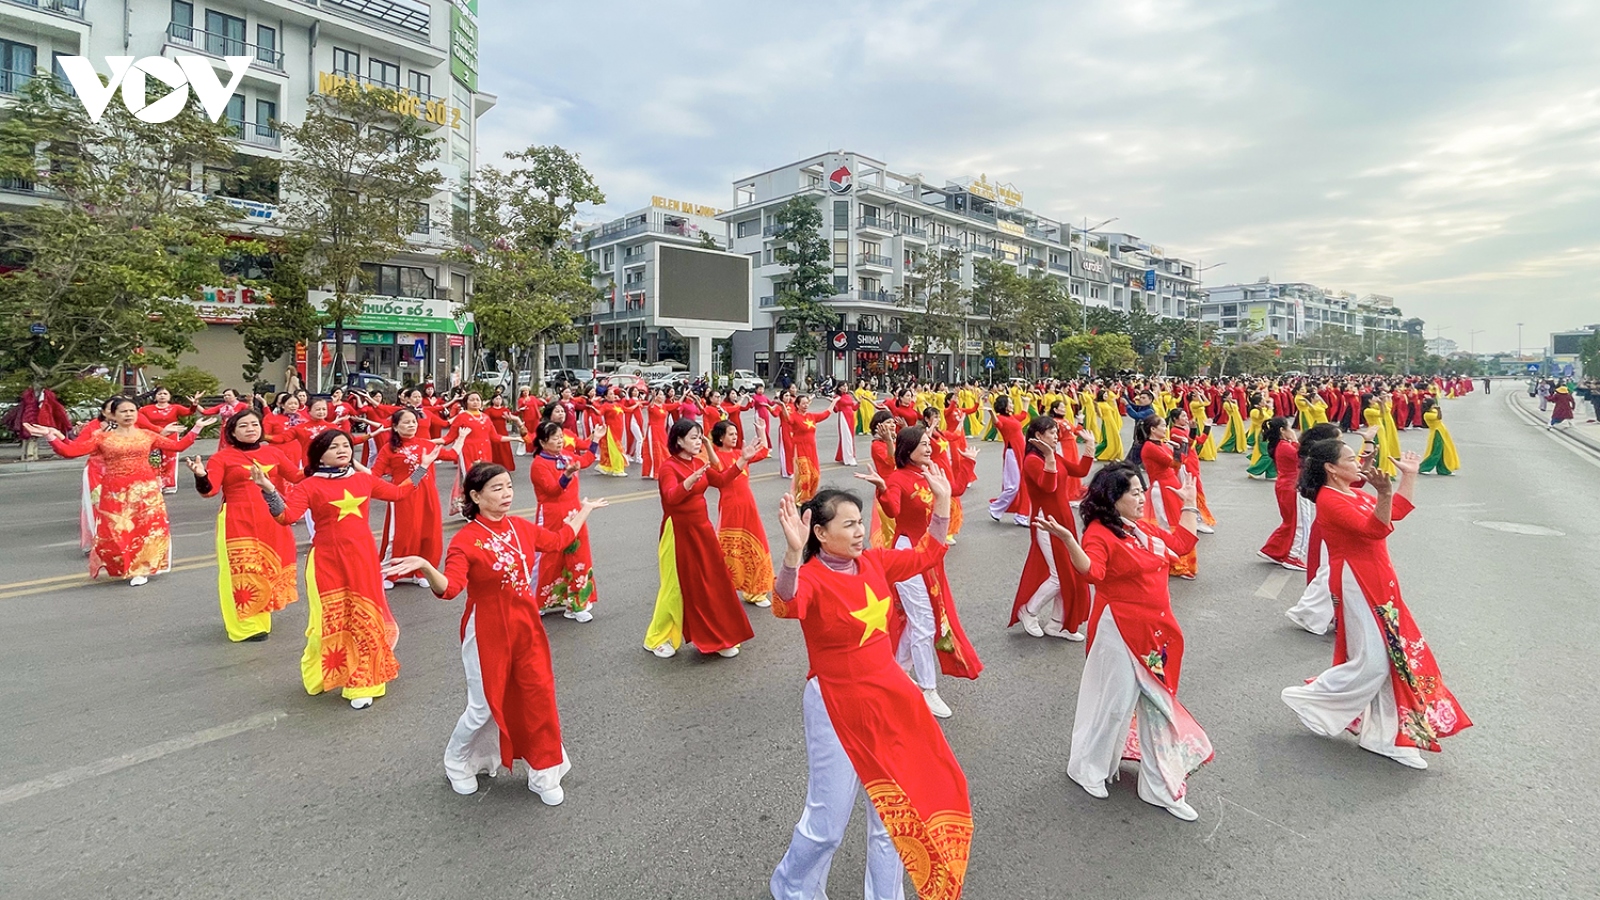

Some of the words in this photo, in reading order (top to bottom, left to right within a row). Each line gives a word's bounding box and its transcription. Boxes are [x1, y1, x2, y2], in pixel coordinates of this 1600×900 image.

[463, 70, 470, 82] 2
[425, 97, 446, 126] SỐ
[451, 107, 461, 129] 2
[652, 195, 679, 212] HELEN
[362, 301, 403, 315] THUỐC
[426, 308, 434, 317] 2
[857, 334, 880, 345] SHIMA
